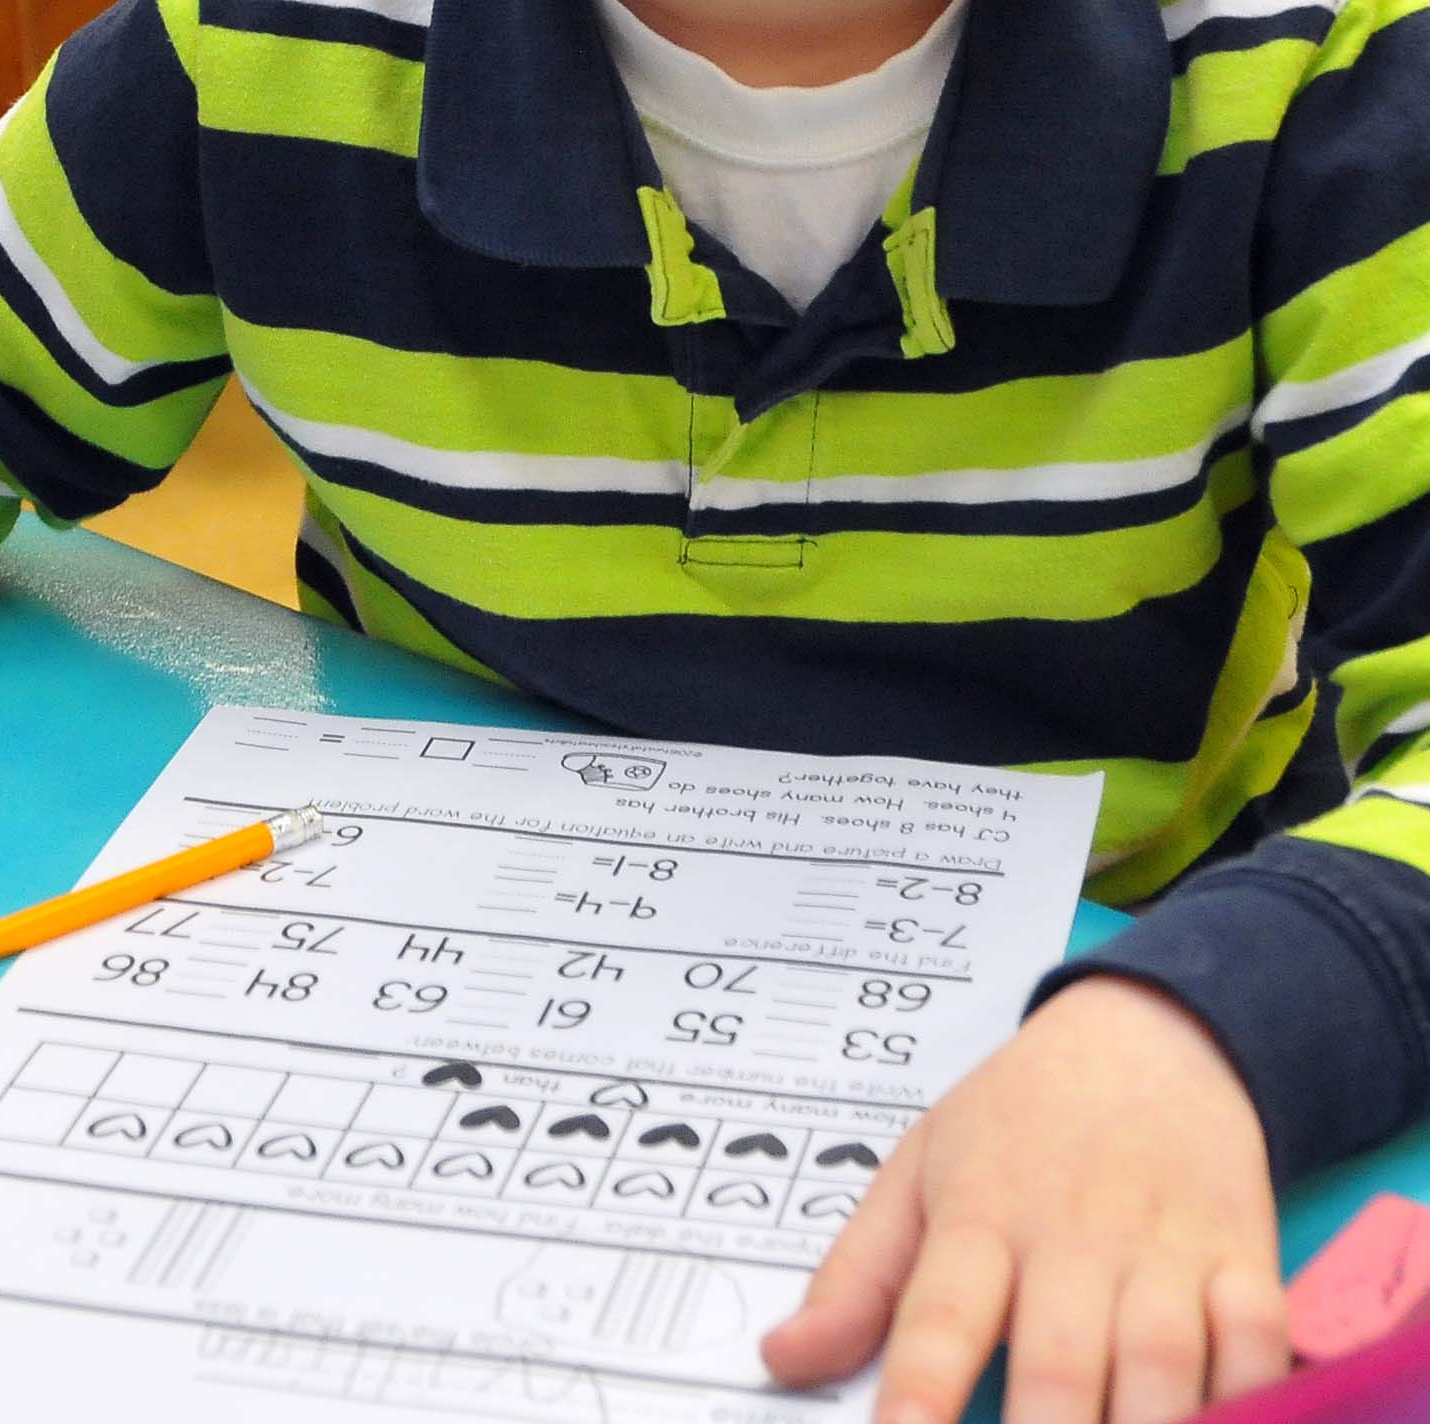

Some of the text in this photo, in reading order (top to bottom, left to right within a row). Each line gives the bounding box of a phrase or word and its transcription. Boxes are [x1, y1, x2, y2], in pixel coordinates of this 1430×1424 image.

[778, 770, 1023, 801] they have together?
[405, 805, 461, 823] word
[668, 782, 1017, 823] 4 shoes. How many shoes do
[469, 812, 506, 829] the
[514, 816, 552, 833] for
[559, 820, 656, 840] equation
[615, 798, 1011, 843] CJ has 8 shoes. His brother has
[666, 833, 695, 845] an
[705, 836, 763, 853] write
[770, 840, 813, 857] and
[822, 844, 906, 864] picture
[914, 852, 929, 862] a
[939, 854, 1002, 871] Draw
[591, 854, 678, 882] 8-1=
[875, 875, 983, 906] 8-2=
[554, 889, 657, 920] 9-4=
[123, 907, 200, 939] 77
[864, 918, 969, 951] 7-3=
[271, 922, 346, 956] 75
[396, 933, 465, 965] 44
[93, 954, 170, 986] 86
[557, 950, 626, 983] 42
[868, 950, 908, 968] the
[918, 954, 972, 972] Find
[244, 968, 319, 1003] 84
[683, 962, 759, 995] 70
[373, 980, 449, 1014] 63
[857, 979, 933, 1013] 68
[536, 998, 592, 1030] 61
[664, 1010, 744, 1047] 55
[529, 1047, 613, 1066] comes
[839, 1029, 917, 1067] 53
[625, 1056, 675, 1077] that
[687, 1062, 784, 1087] number
[502, 1072, 562, 1093] than
[794, 1076, 836, 1094] the
[679, 1092, 752, 1110] more
[763, 1099, 838, 1119] many
[851, 1111, 909, 1131] How
